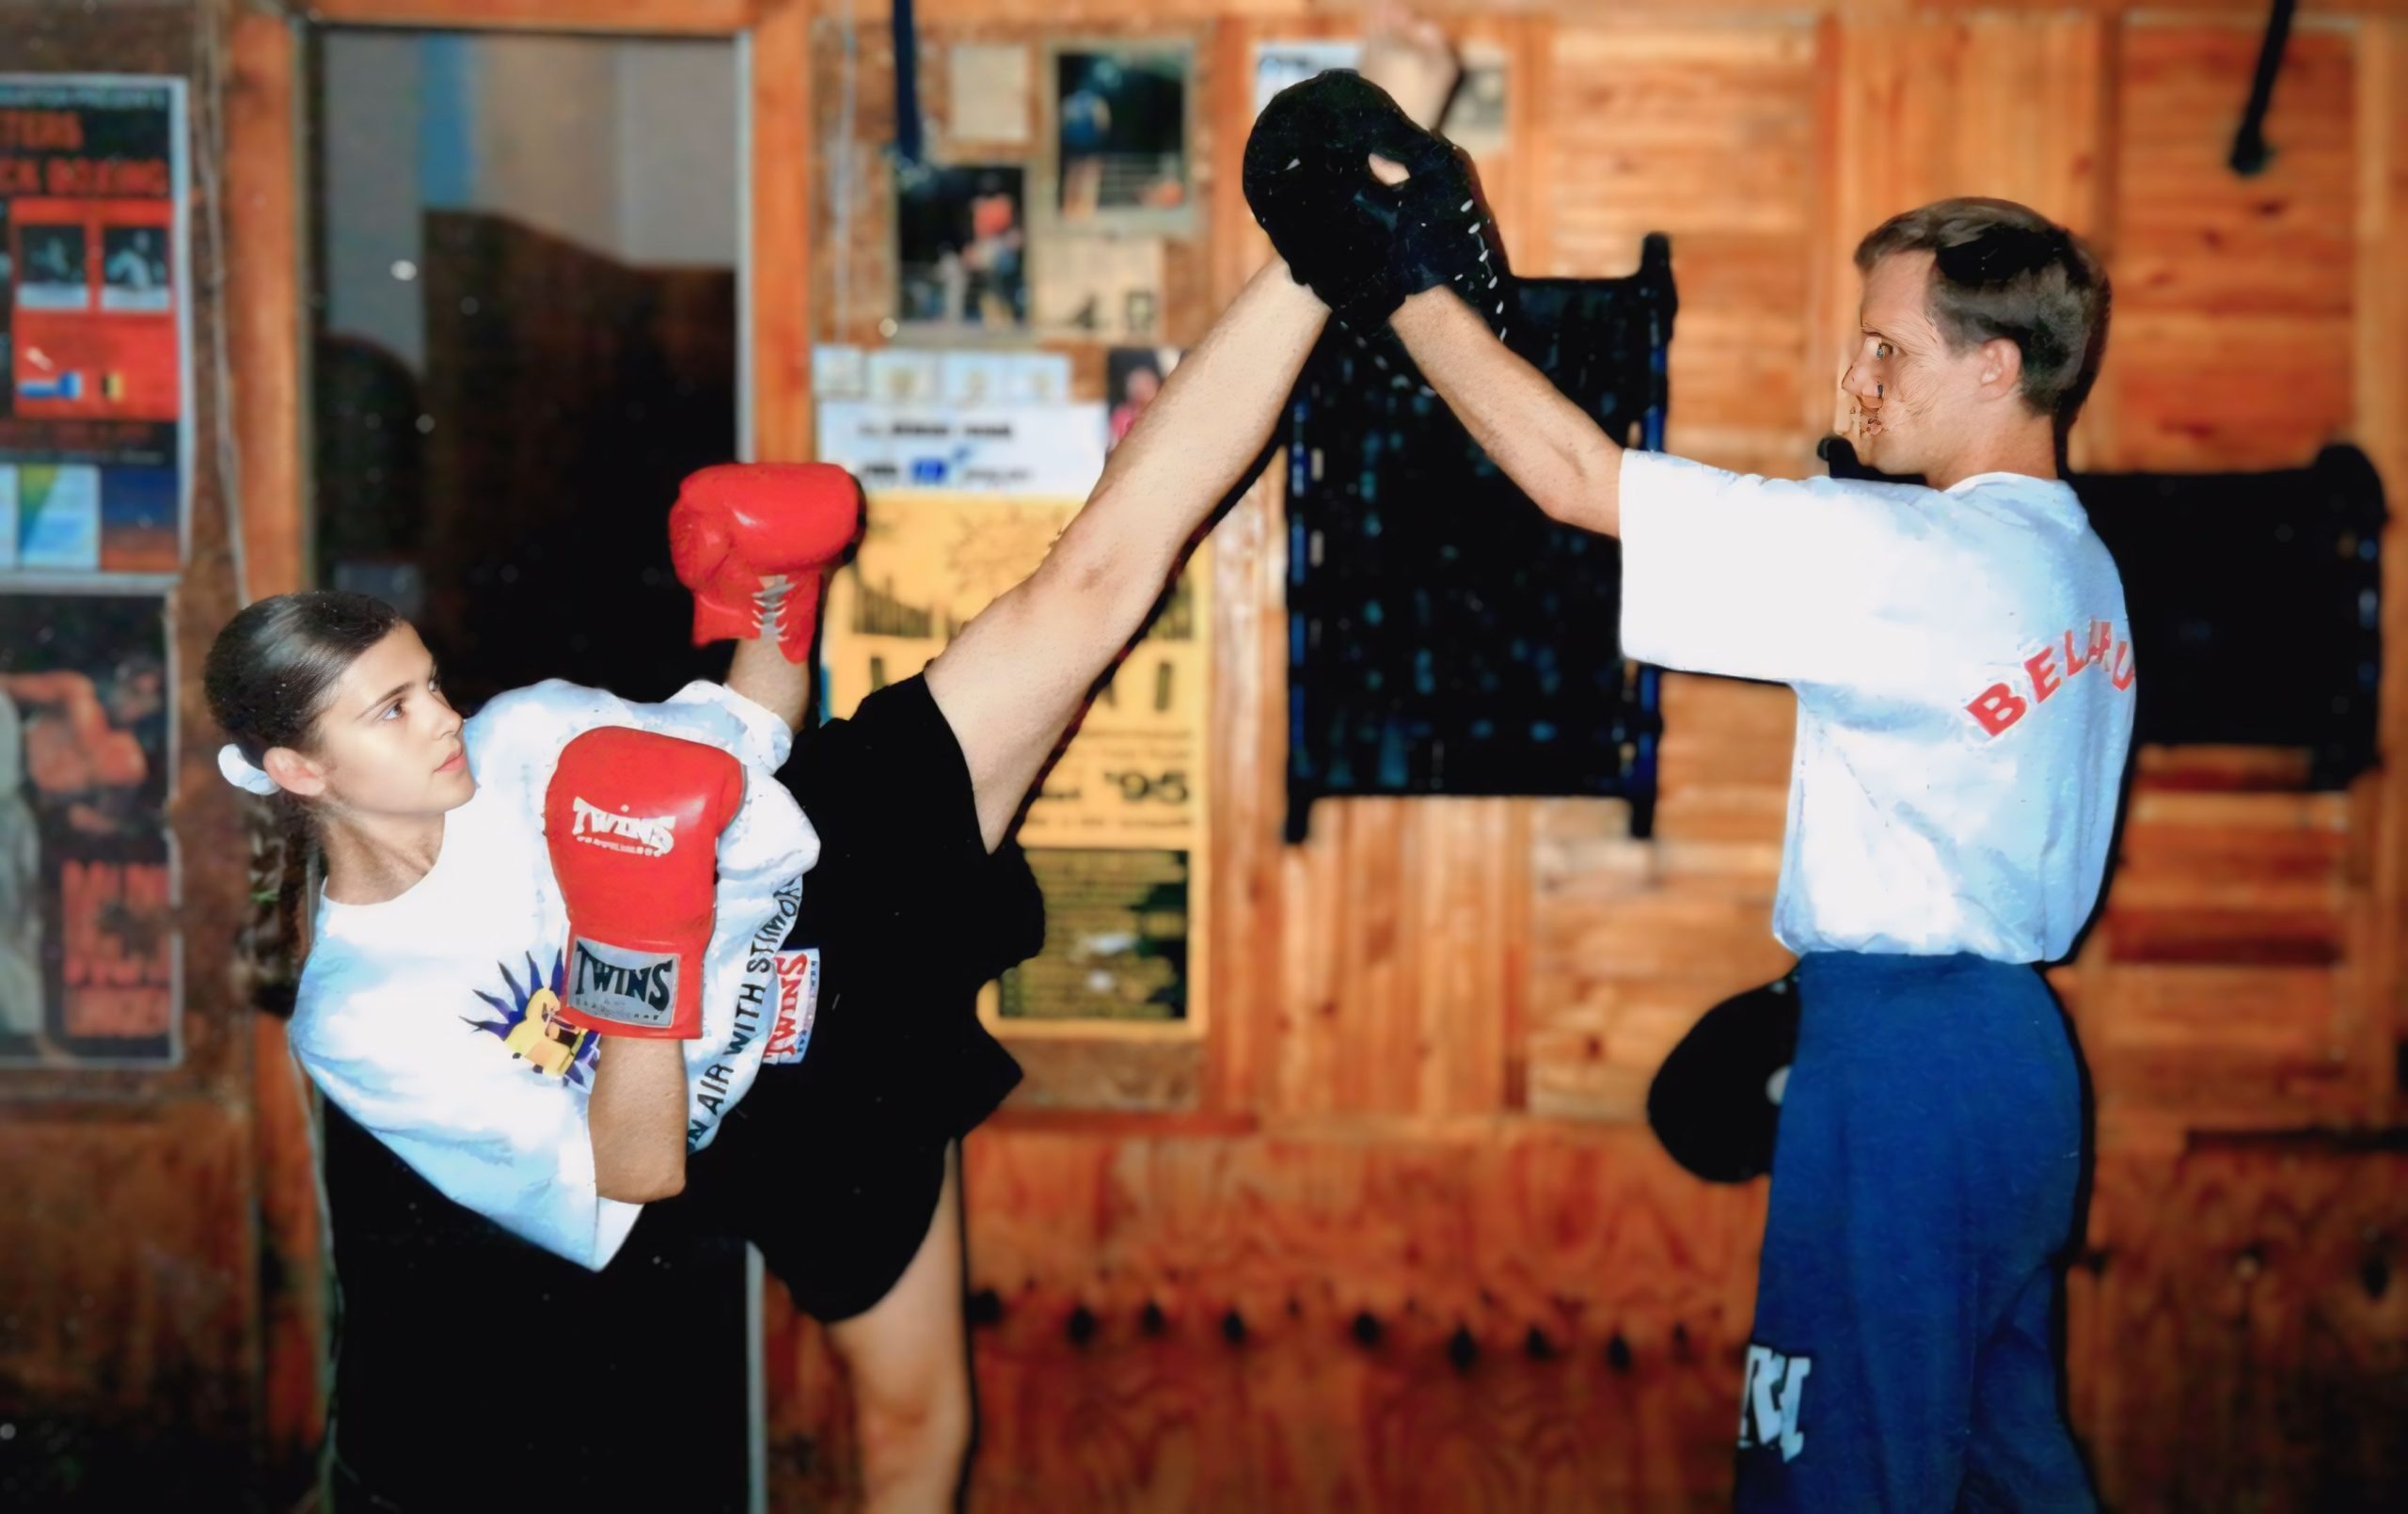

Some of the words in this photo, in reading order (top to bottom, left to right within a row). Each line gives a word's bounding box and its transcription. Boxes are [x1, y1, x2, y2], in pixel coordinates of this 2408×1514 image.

[572, 796, 676, 855] TWINS
[575, 940, 673, 1012] TWINS
[762, 953, 808, 1058] TWINS
[698, 1064, 735, 1116] AIR
[723, 983, 767, 1055] WITH
